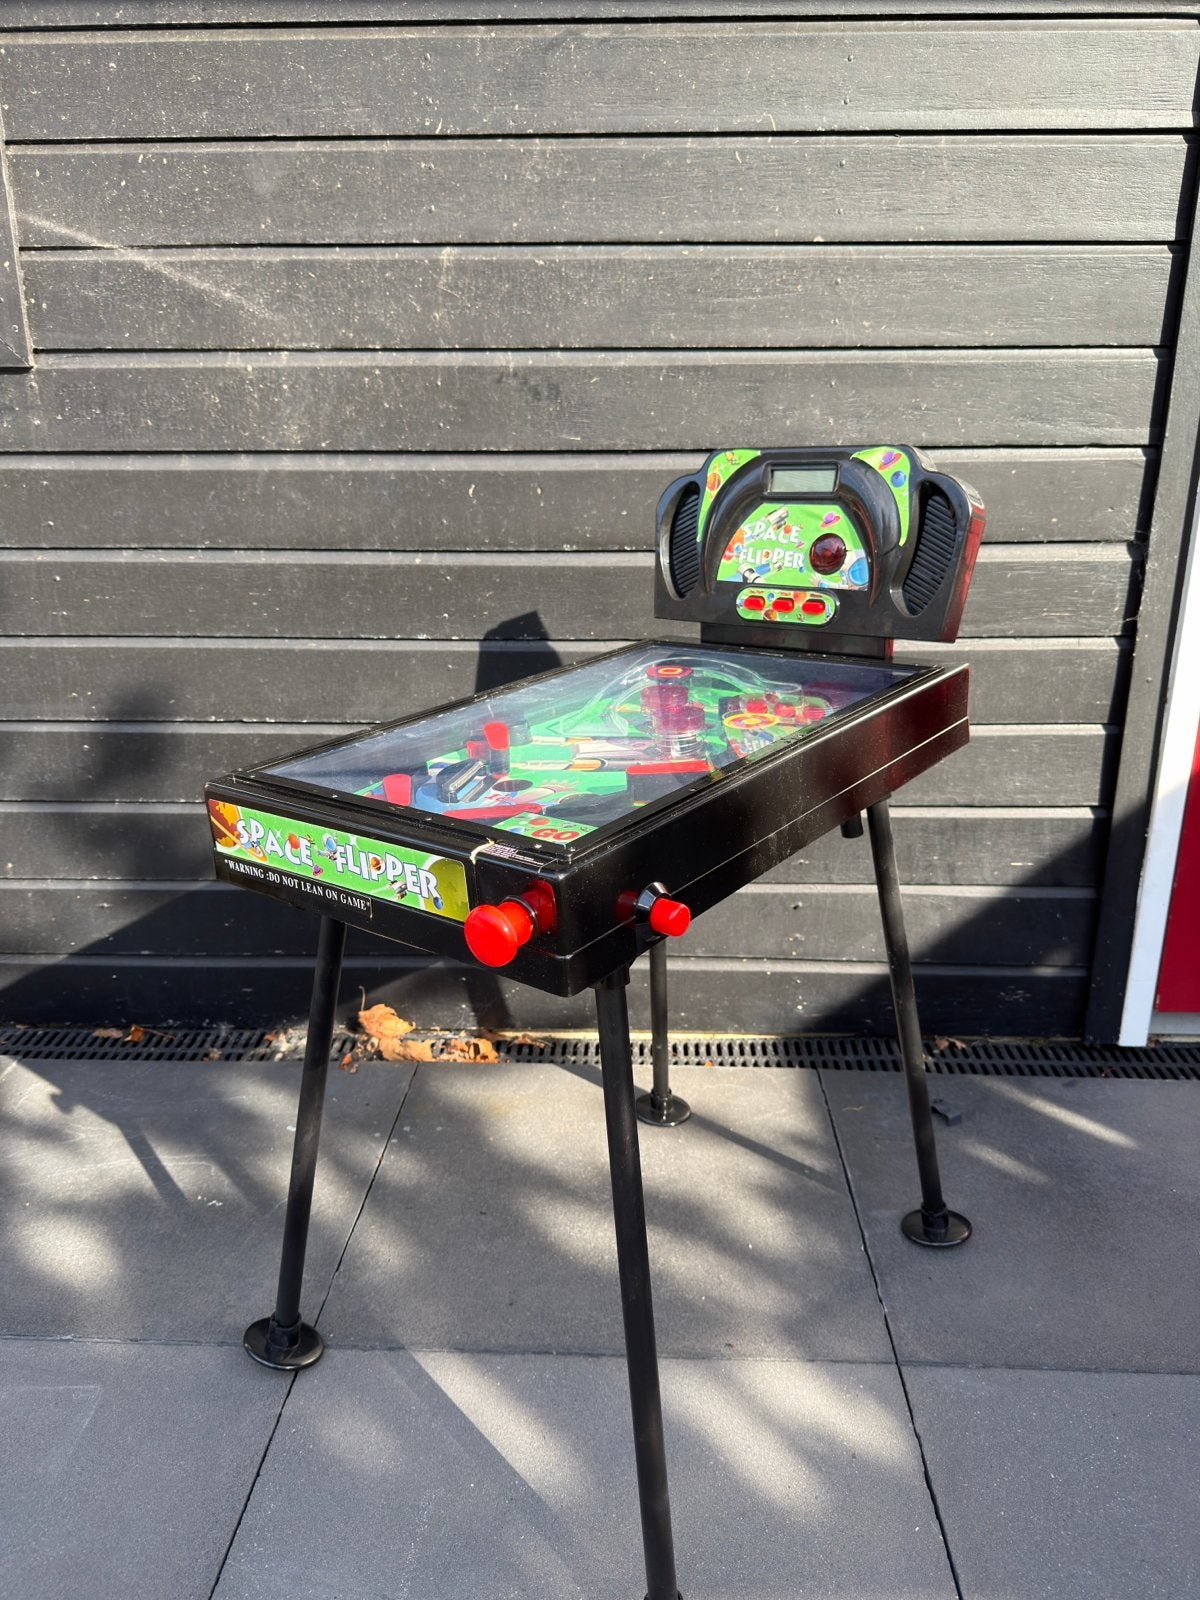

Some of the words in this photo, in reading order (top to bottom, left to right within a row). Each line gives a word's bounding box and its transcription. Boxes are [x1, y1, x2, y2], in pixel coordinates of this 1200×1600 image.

[743, 520, 800, 544] SPACE
[738, 547, 804, 568] FLIPPER
[531, 828, 580, 840] GO
[236, 817, 314, 867] SPACE
[335, 843, 441, 900] FLIPPER
[282, 877, 299, 889] NOT
[301, 881, 323, 897] LEAN
[325, 888, 338, 901] ON
